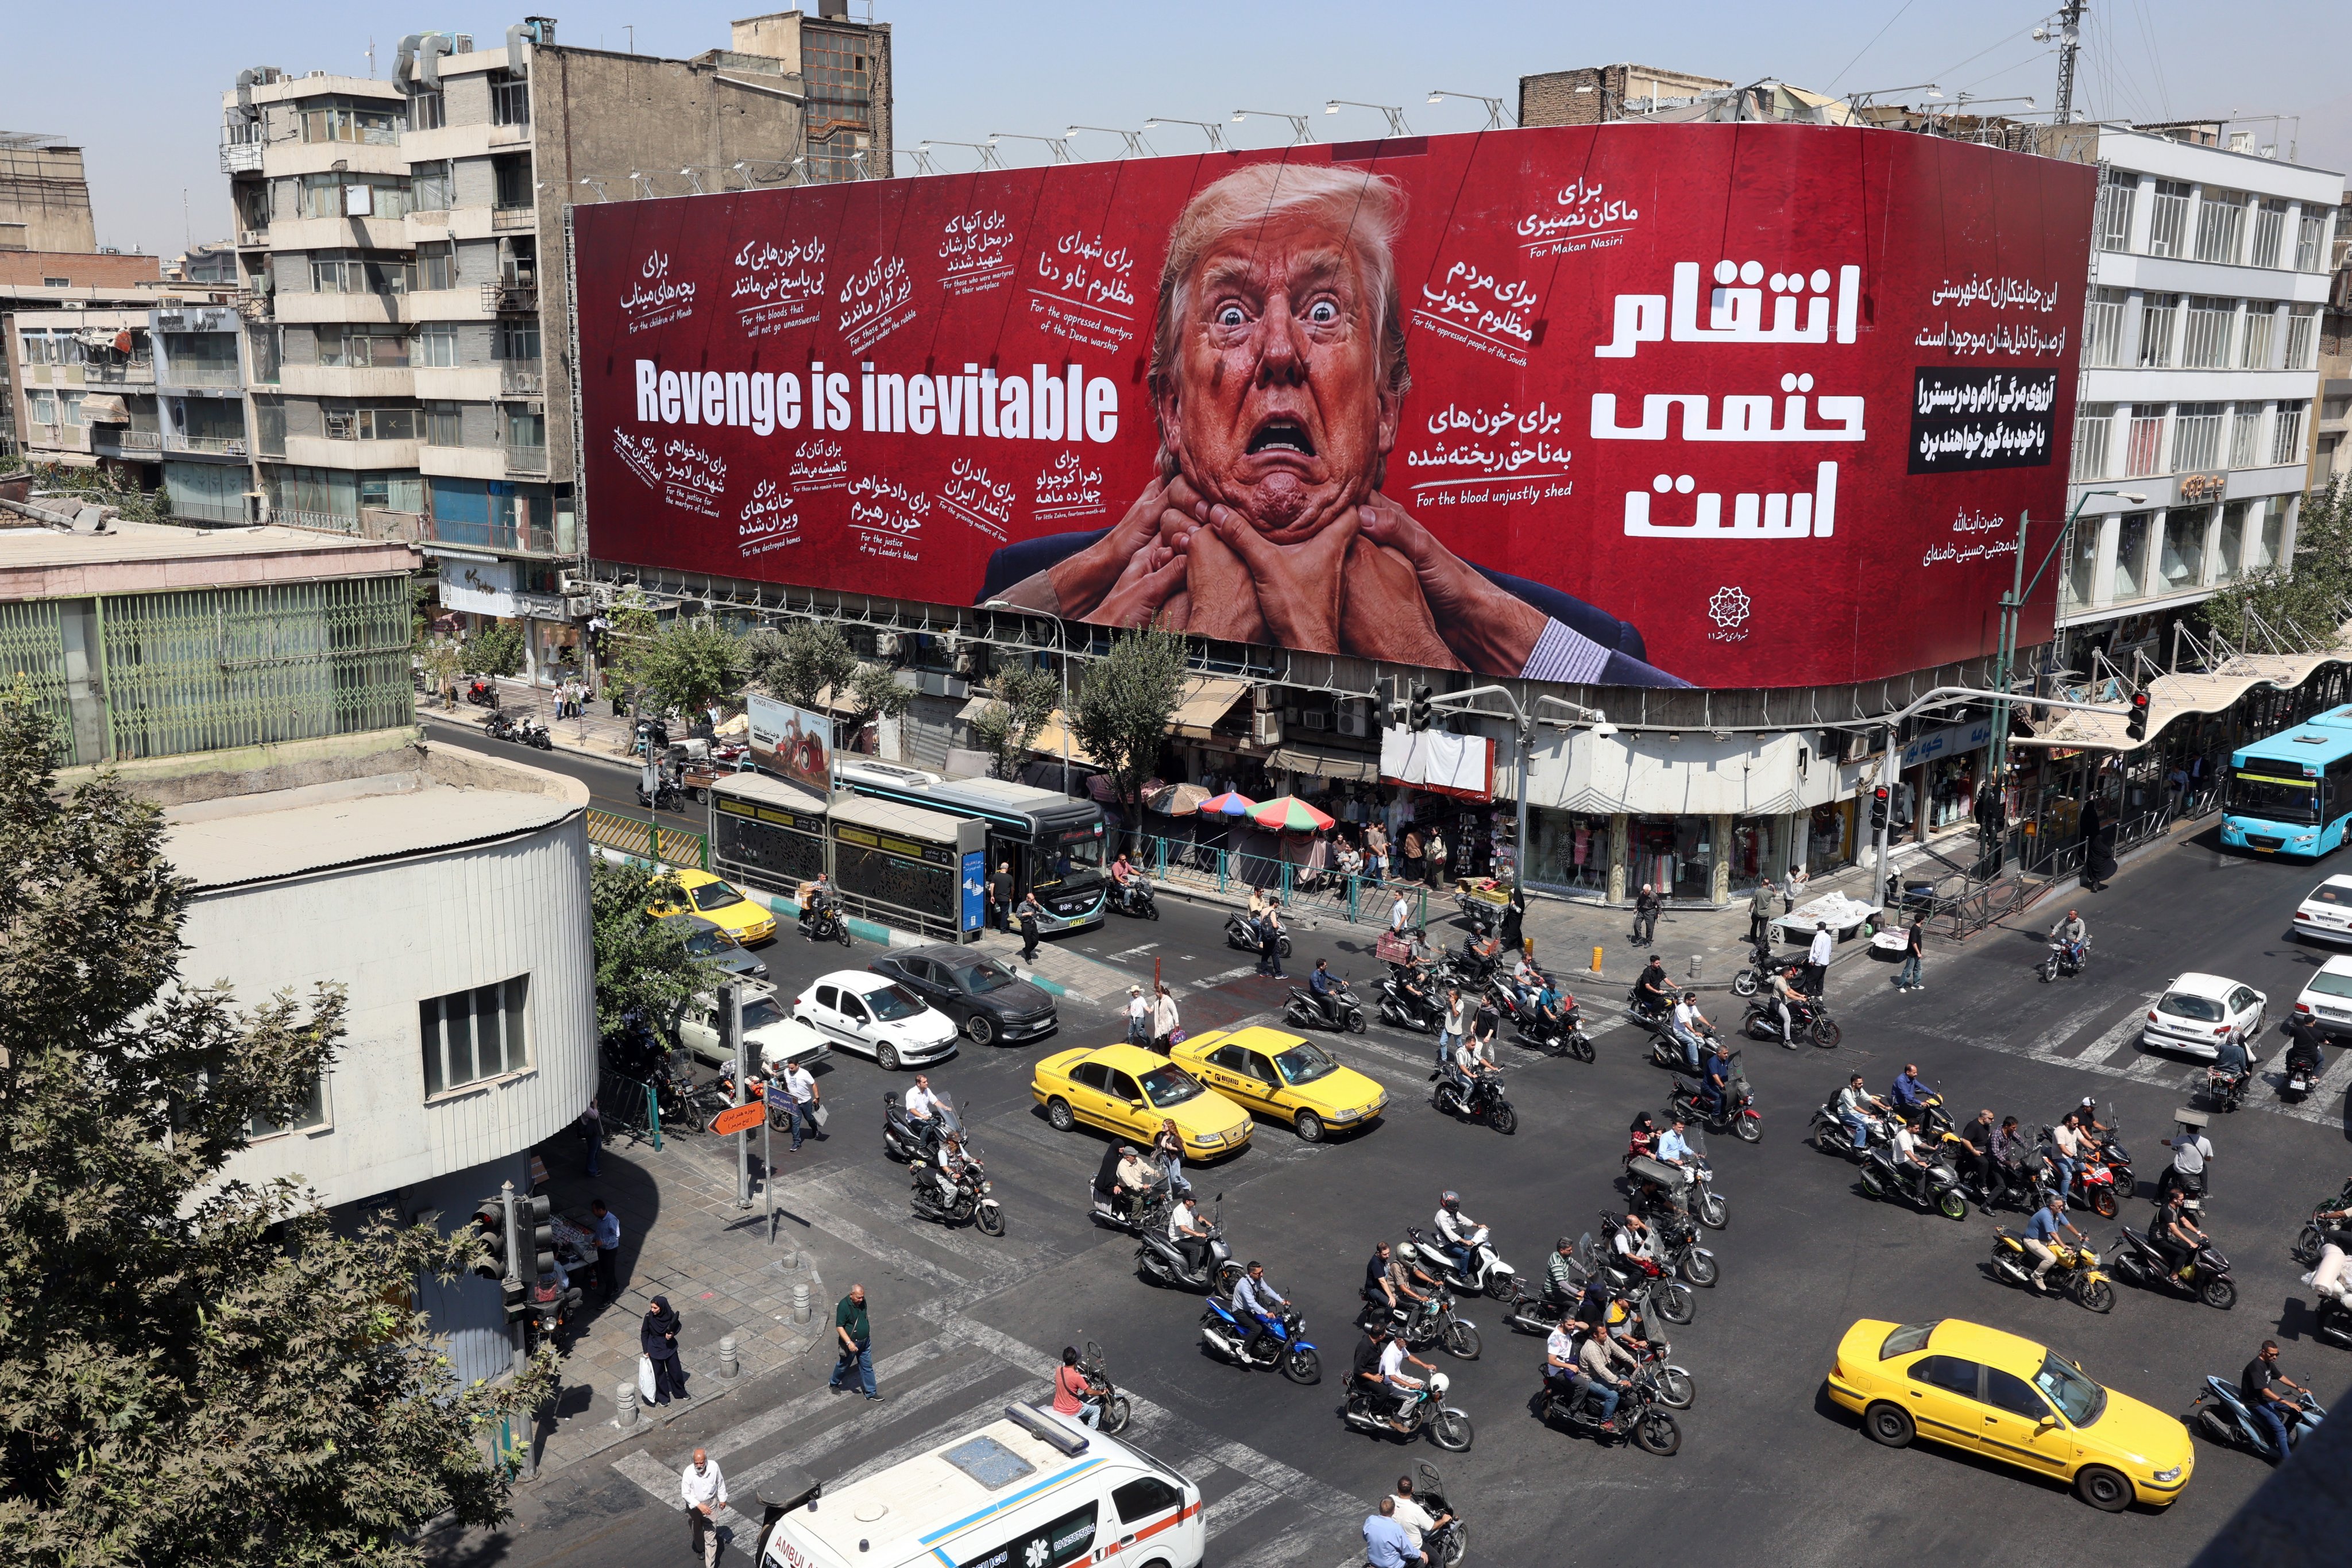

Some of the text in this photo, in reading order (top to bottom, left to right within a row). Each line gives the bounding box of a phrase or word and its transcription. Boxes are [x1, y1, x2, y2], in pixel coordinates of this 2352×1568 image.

[1558, 177, 1602, 205] برای
[1517, 200, 1638, 237] ماکان نصیری
[735, 241, 755, 267] که
[803, 236, 825, 262] برای
[1058, 231, 1133, 277] برای شهدای
[1530, 235, 1623, 258] For Makan Nasiri
[643, 250, 667, 278] برای
[1040, 252, 1133, 305] مظلوم ناو دنا
[1932, 273, 2057, 312] این جنایتکاران که فهرستی
[621, 282, 654, 314] میناب
[1594, 260, 1860, 358] انتقام
[629, 323, 638, 334] For
[650, 316, 667, 327] children
[670, 312, 674, 321] of
[677, 306, 692, 319] Minab
[742, 303, 804, 327] For the bloods that
[748, 311, 820, 337] will not go unanswered
[1030, 299, 1133, 341] For the oppressed martyrs
[1041, 320, 1118, 354] of the Dena warship
[1948, 329, 1986, 355] موجود
[2030, 325, 2038, 349] تا
[2036, 334, 2057, 357] صدر
[2056, 326, 2065, 357] از
[636, 359, 1118, 443] Revenge is inevitable
[1590, 372, 1866, 442] حتمی
[1918, 377, 1928, 414] را
[1925, 381, 1957, 414] بستر
[1955, 384, 1971, 414] در
[1978, 374, 2002, 413] آرام
[1998, 376, 2026, 413] مرگی
[2026, 375, 2056, 412] آرزوی
[1518, 401, 1562, 434] برای
[1920, 421, 2045, 462] با خود به گور خواهند برد
[1055, 450, 1079, 469] برای
[754, 479, 775, 498] برای
[1037, 467, 1102, 490] زهرا کوچولو
[848, 475, 930, 516] برای دادخواهی
[1036, 488, 1100, 504] چهارده ماهه
[1417, 481, 1573, 508] For the blood unjustly shed
[1624, 461, 1838, 539] است
[852, 502, 921, 533] خون رهبرم
[1068, 508, 1105, 516] fourteen-month-old
[1979, 513, 2003, 534] حضرت
[743, 549, 751, 557] For
[762, 538, 785, 551] destroyed
[787, 536, 800, 544] homes
[860, 543, 918, 561] of my Leader's blood
[862, 532, 902, 547] For the justice
[1956, 544, 1985, 563] حسینی
[1715, 629, 1728, 639] منطقه
[1726, 628, 1749, 642] شهرداری
[753, 697, 766, 706] HONOR
[1921, 733, 1942, 758] کوه
[1222, 1075, 1239, 1086] 1839
[1053, 1523, 1095, 1551] 09125875694
[990, 1551, 1007, 1567] ICU
